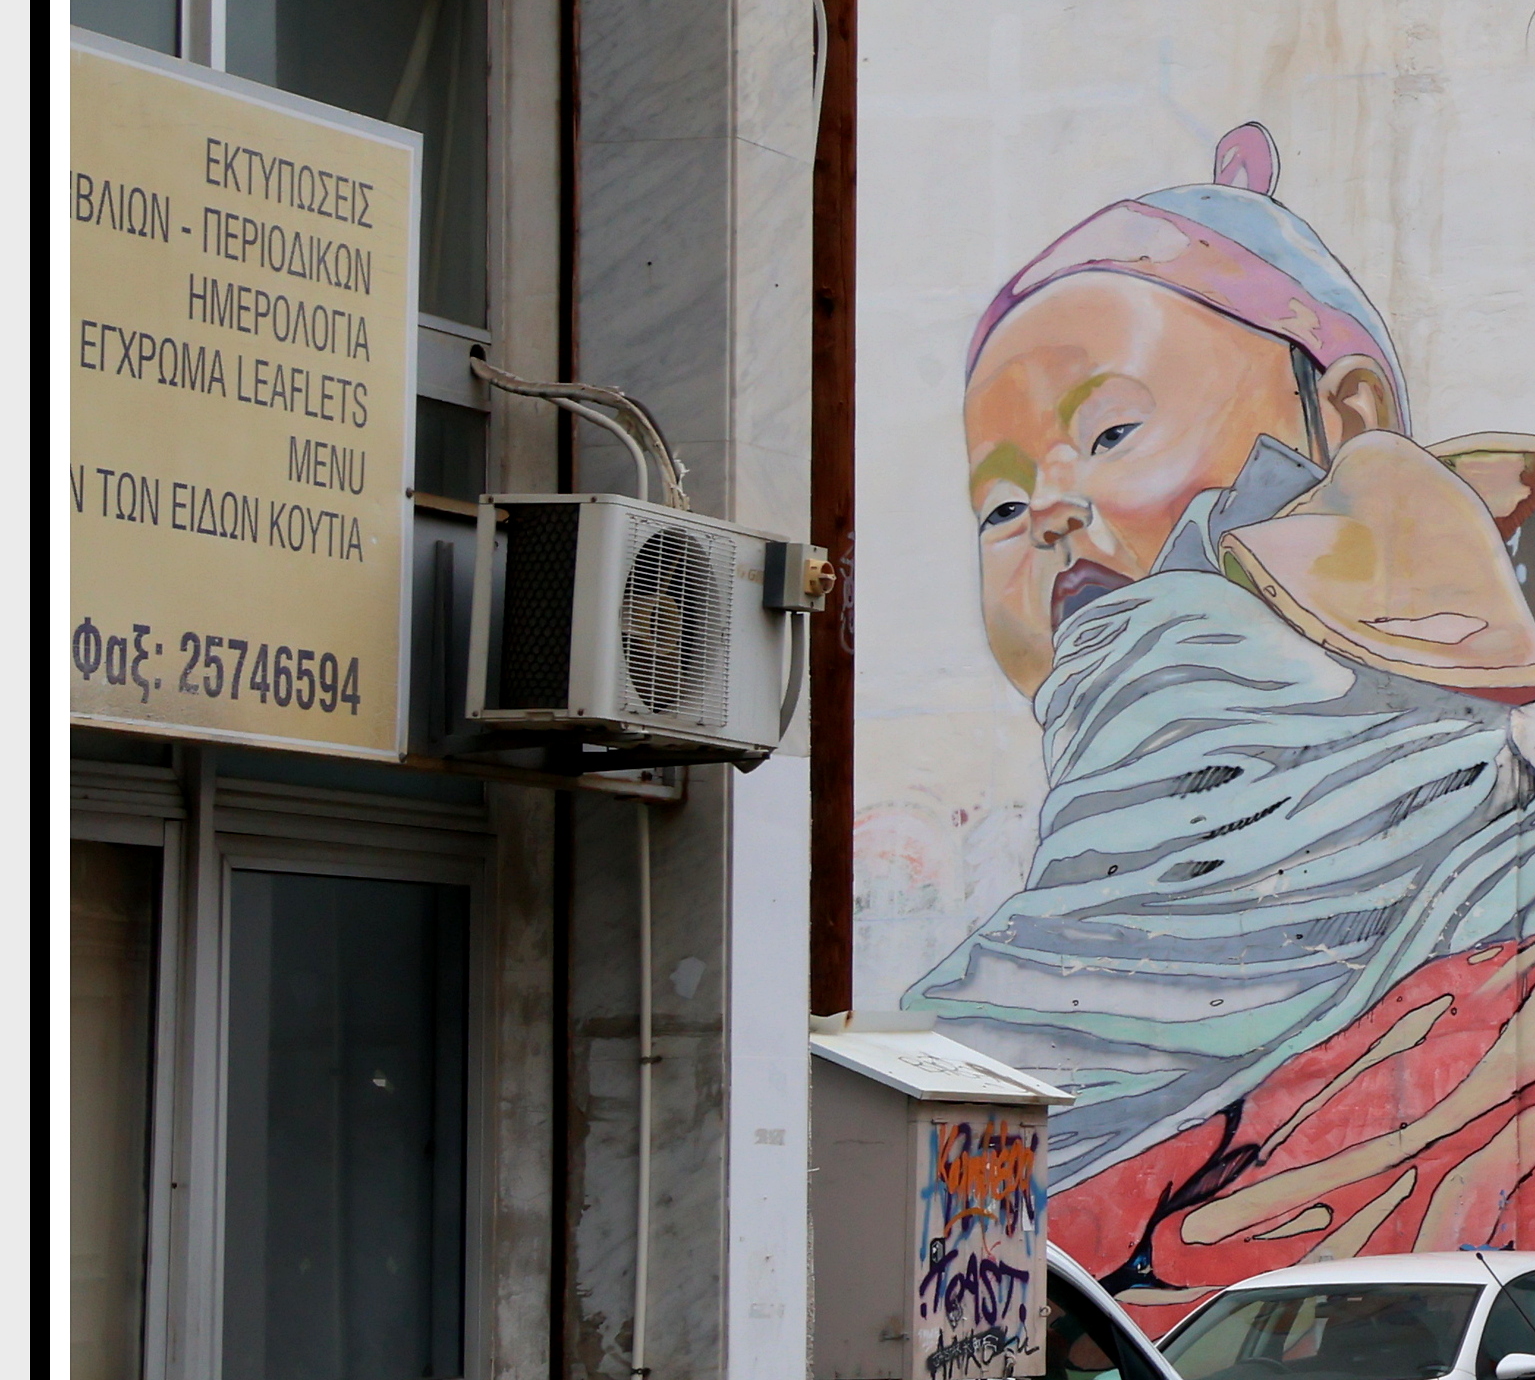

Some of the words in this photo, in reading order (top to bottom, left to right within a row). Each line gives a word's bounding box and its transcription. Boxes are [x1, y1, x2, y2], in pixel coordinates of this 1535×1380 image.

[206, 137, 373, 228] ΕΚΤΥΠΩΣΕΙΣ
[203, 207, 371, 295] ΠΕΡΙΟΔΙΚΩΝ
[189, 273, 370, 362] ΗΜΕΡΟΛΟΓΙΑ
[80, 319, 226, 397] ΕΓΧΡΩΜΑ
[237, 354, 368, 428] LEAFLETS
[289, 436, 365, 495] MENU
[96, 468, 159, 526] ΤΩΝ
[172, 482, 259, 543] ΕΙΔΩΝ
[269, 500, 363, 562] ΚΟΥΤΙΑ
[72, 617, 163, 703] Φαξ:
[179, 631, 361, 715] 25746594
